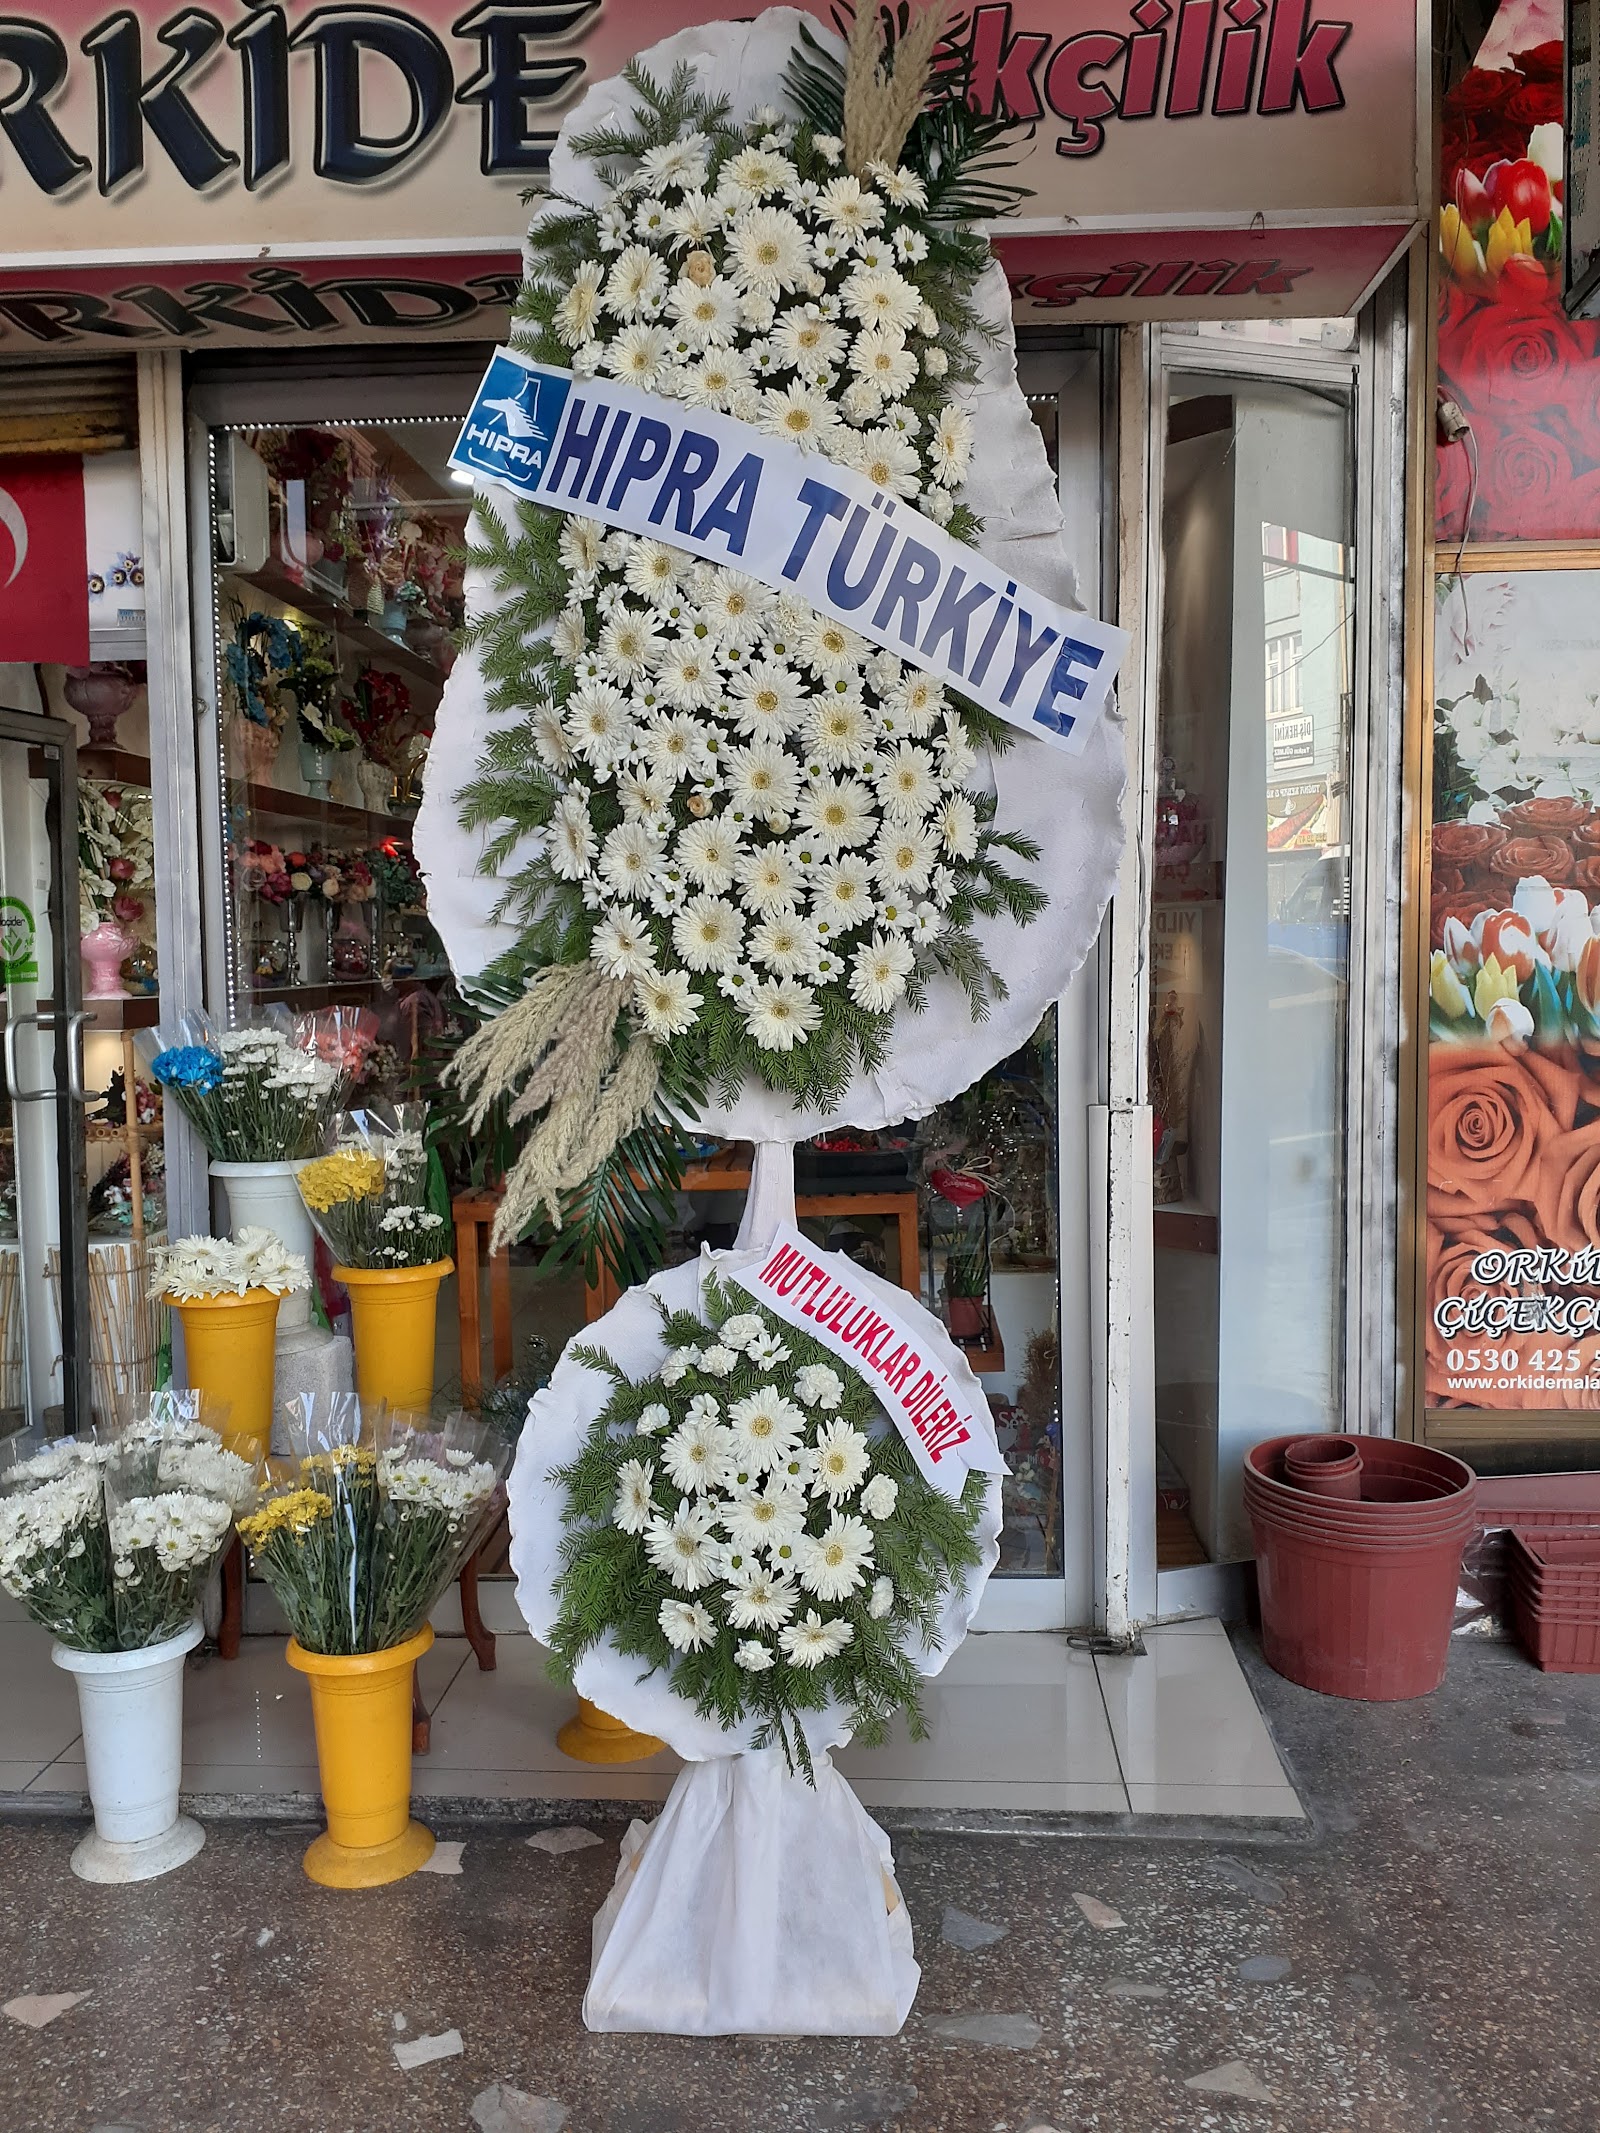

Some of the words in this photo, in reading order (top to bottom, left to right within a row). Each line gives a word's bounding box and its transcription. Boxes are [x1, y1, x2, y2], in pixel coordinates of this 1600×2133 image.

[466, 423, 542, 469] HIPRA
[546, 399, 764, 556] HIPRA
[781, 478, 1104, 737] TÜRKİYE
[758, 1242, 922, 1396] MUTLULUKLAR
[900, 1370, 973, 1464] DİLERİZ
[1446, 1348, 1519, 1372] 0530
[1528, 1348, 1581, 1372] 425
